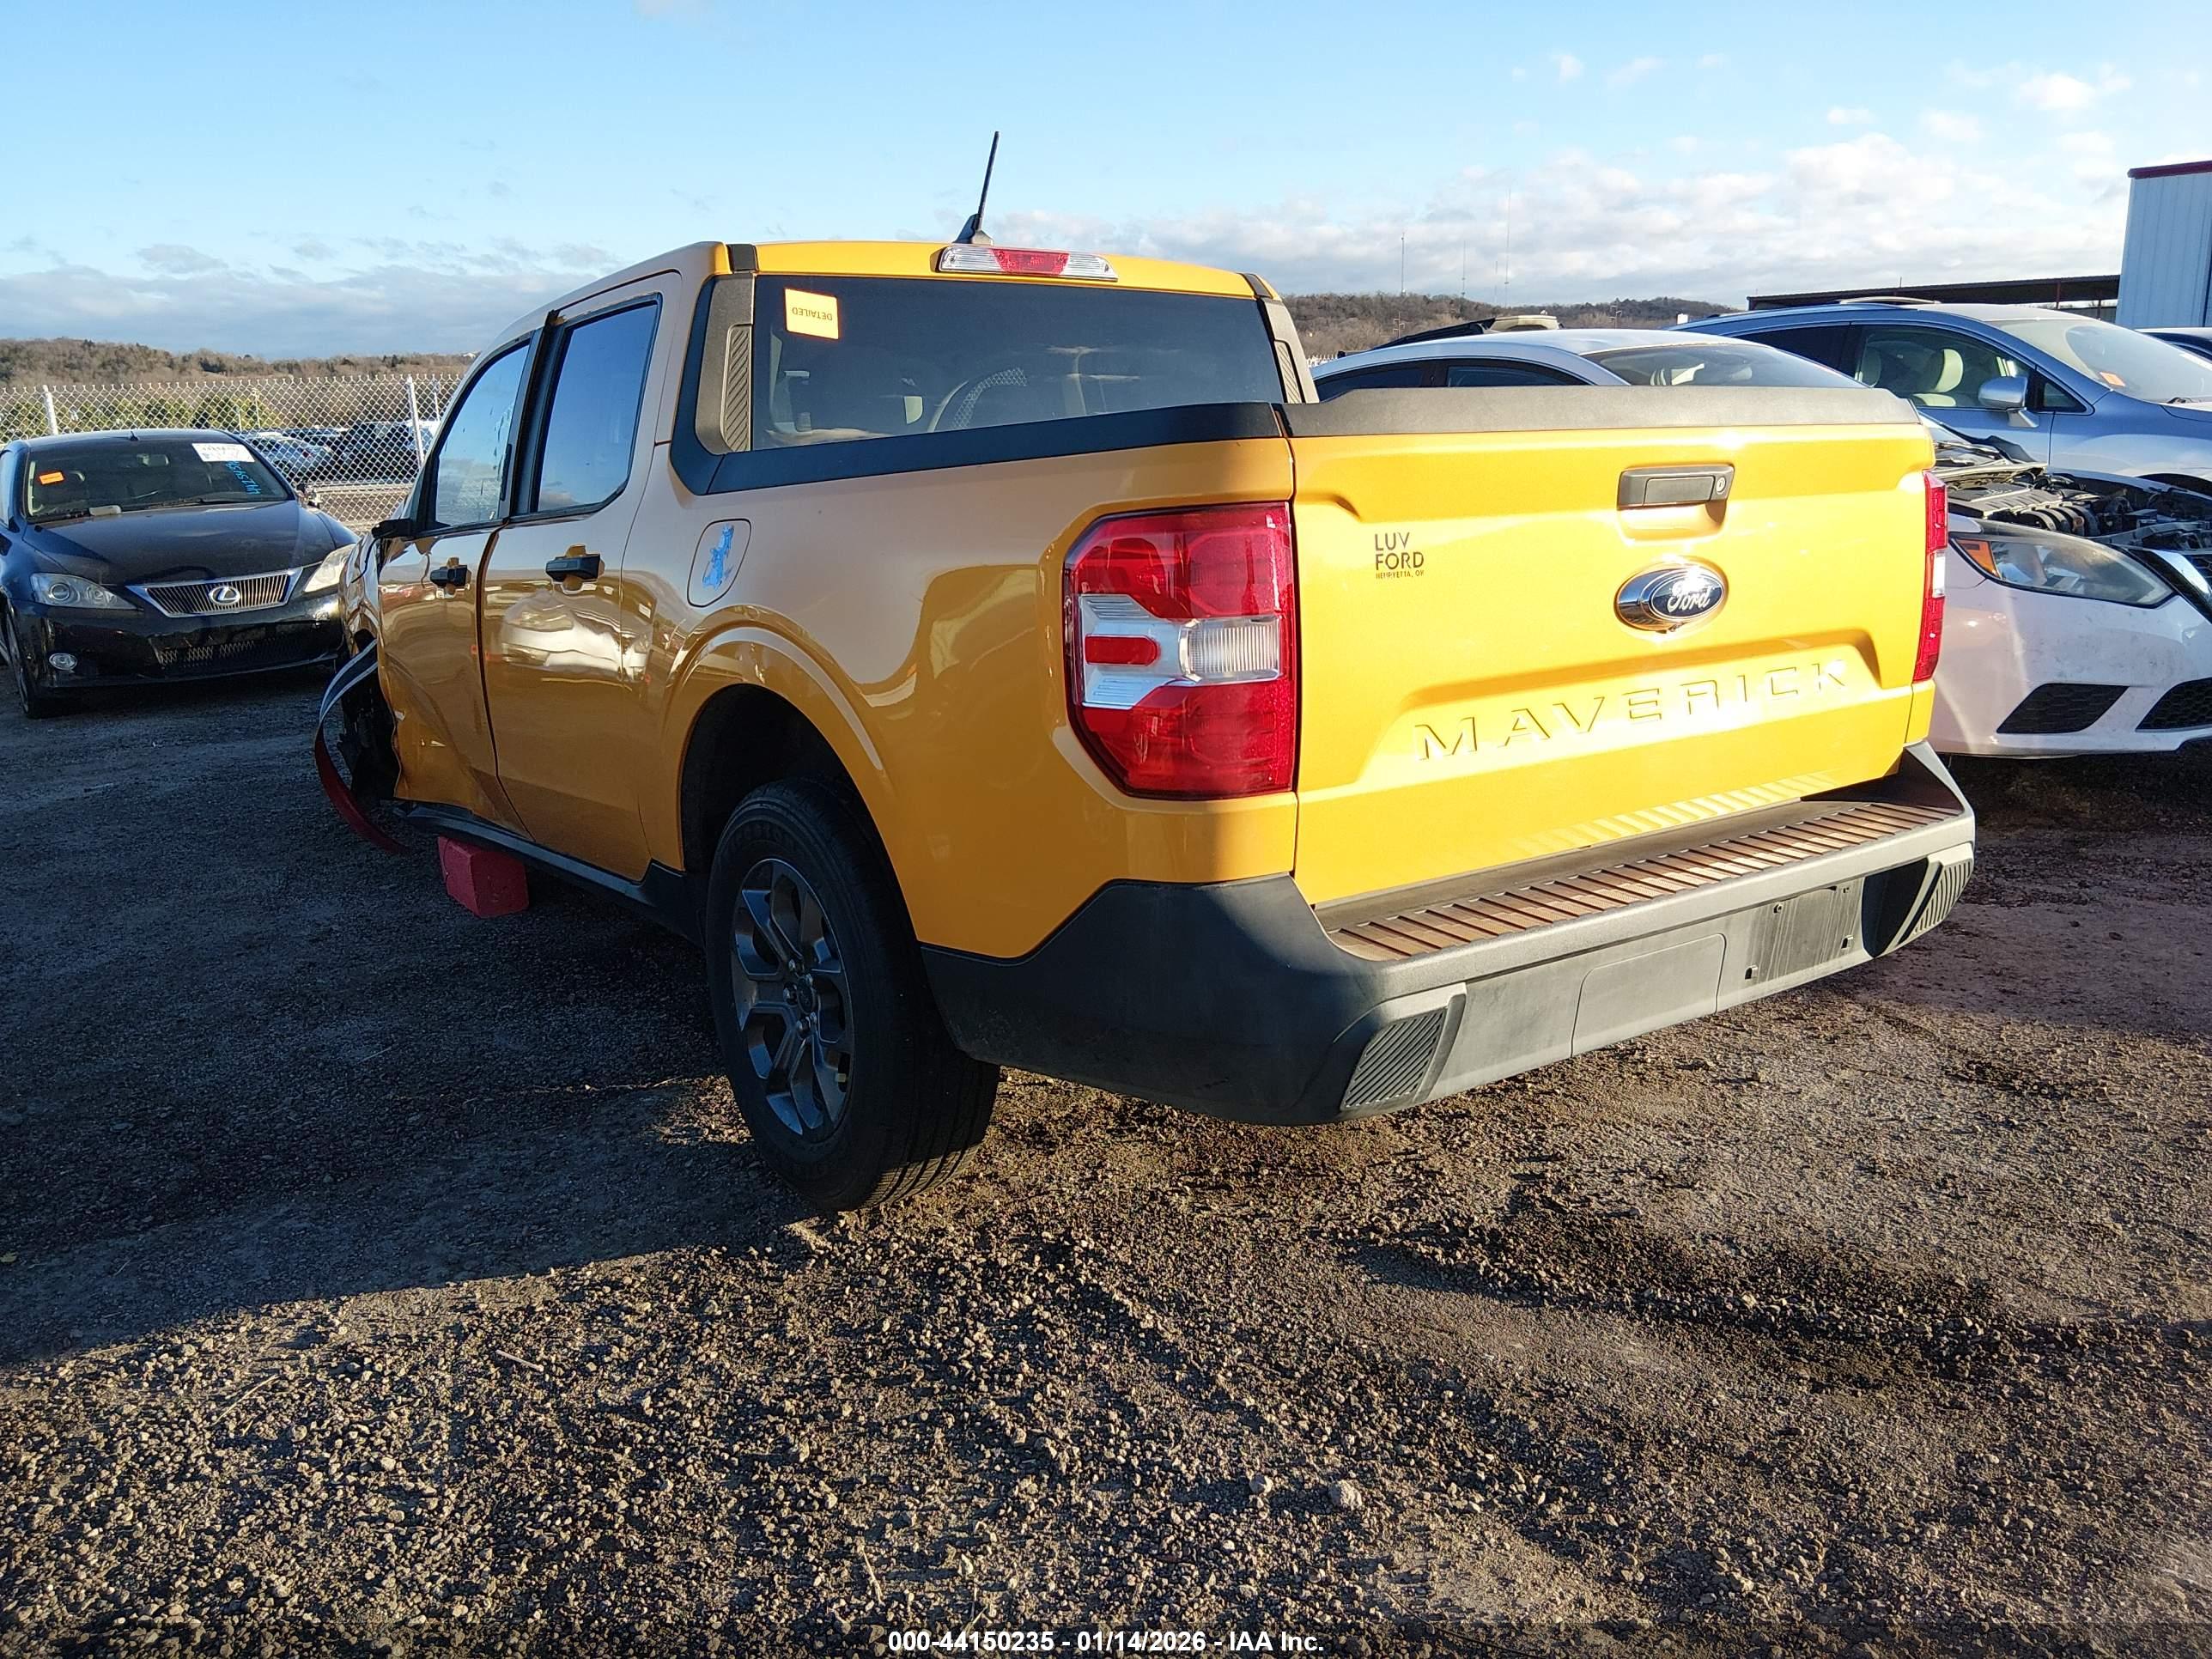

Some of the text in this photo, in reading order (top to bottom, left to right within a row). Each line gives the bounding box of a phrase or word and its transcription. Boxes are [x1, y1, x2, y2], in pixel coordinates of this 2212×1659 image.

[792, 307, 833, 321] DETAILED
[1375, 532, 1410, 551] LUV
[1376, 551, 1425, 570] FORD
[1667, 580, 1715, 613] Ford
[1413, 659, 1847, 762] MAVERICK
